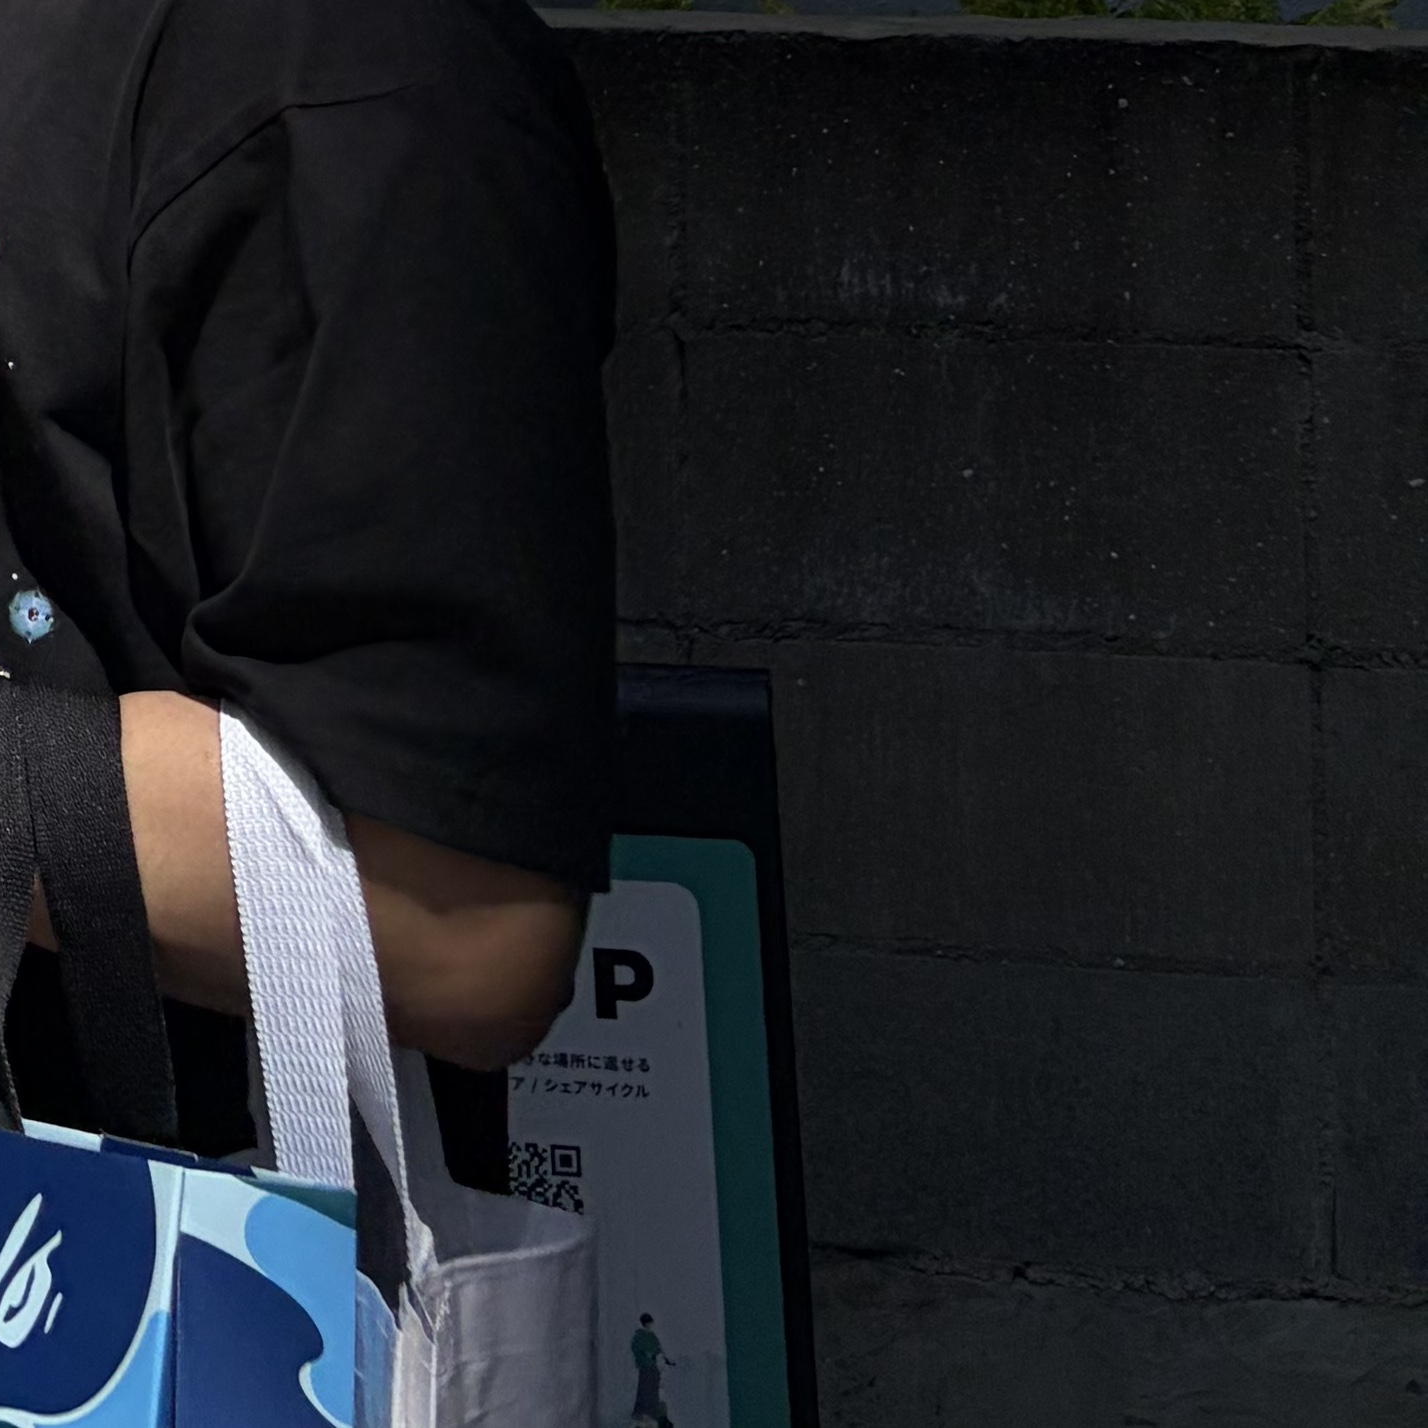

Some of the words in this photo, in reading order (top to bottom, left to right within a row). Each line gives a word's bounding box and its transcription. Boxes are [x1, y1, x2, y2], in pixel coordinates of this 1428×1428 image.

[544, 1078, 651, 1099] シェアサイクル
